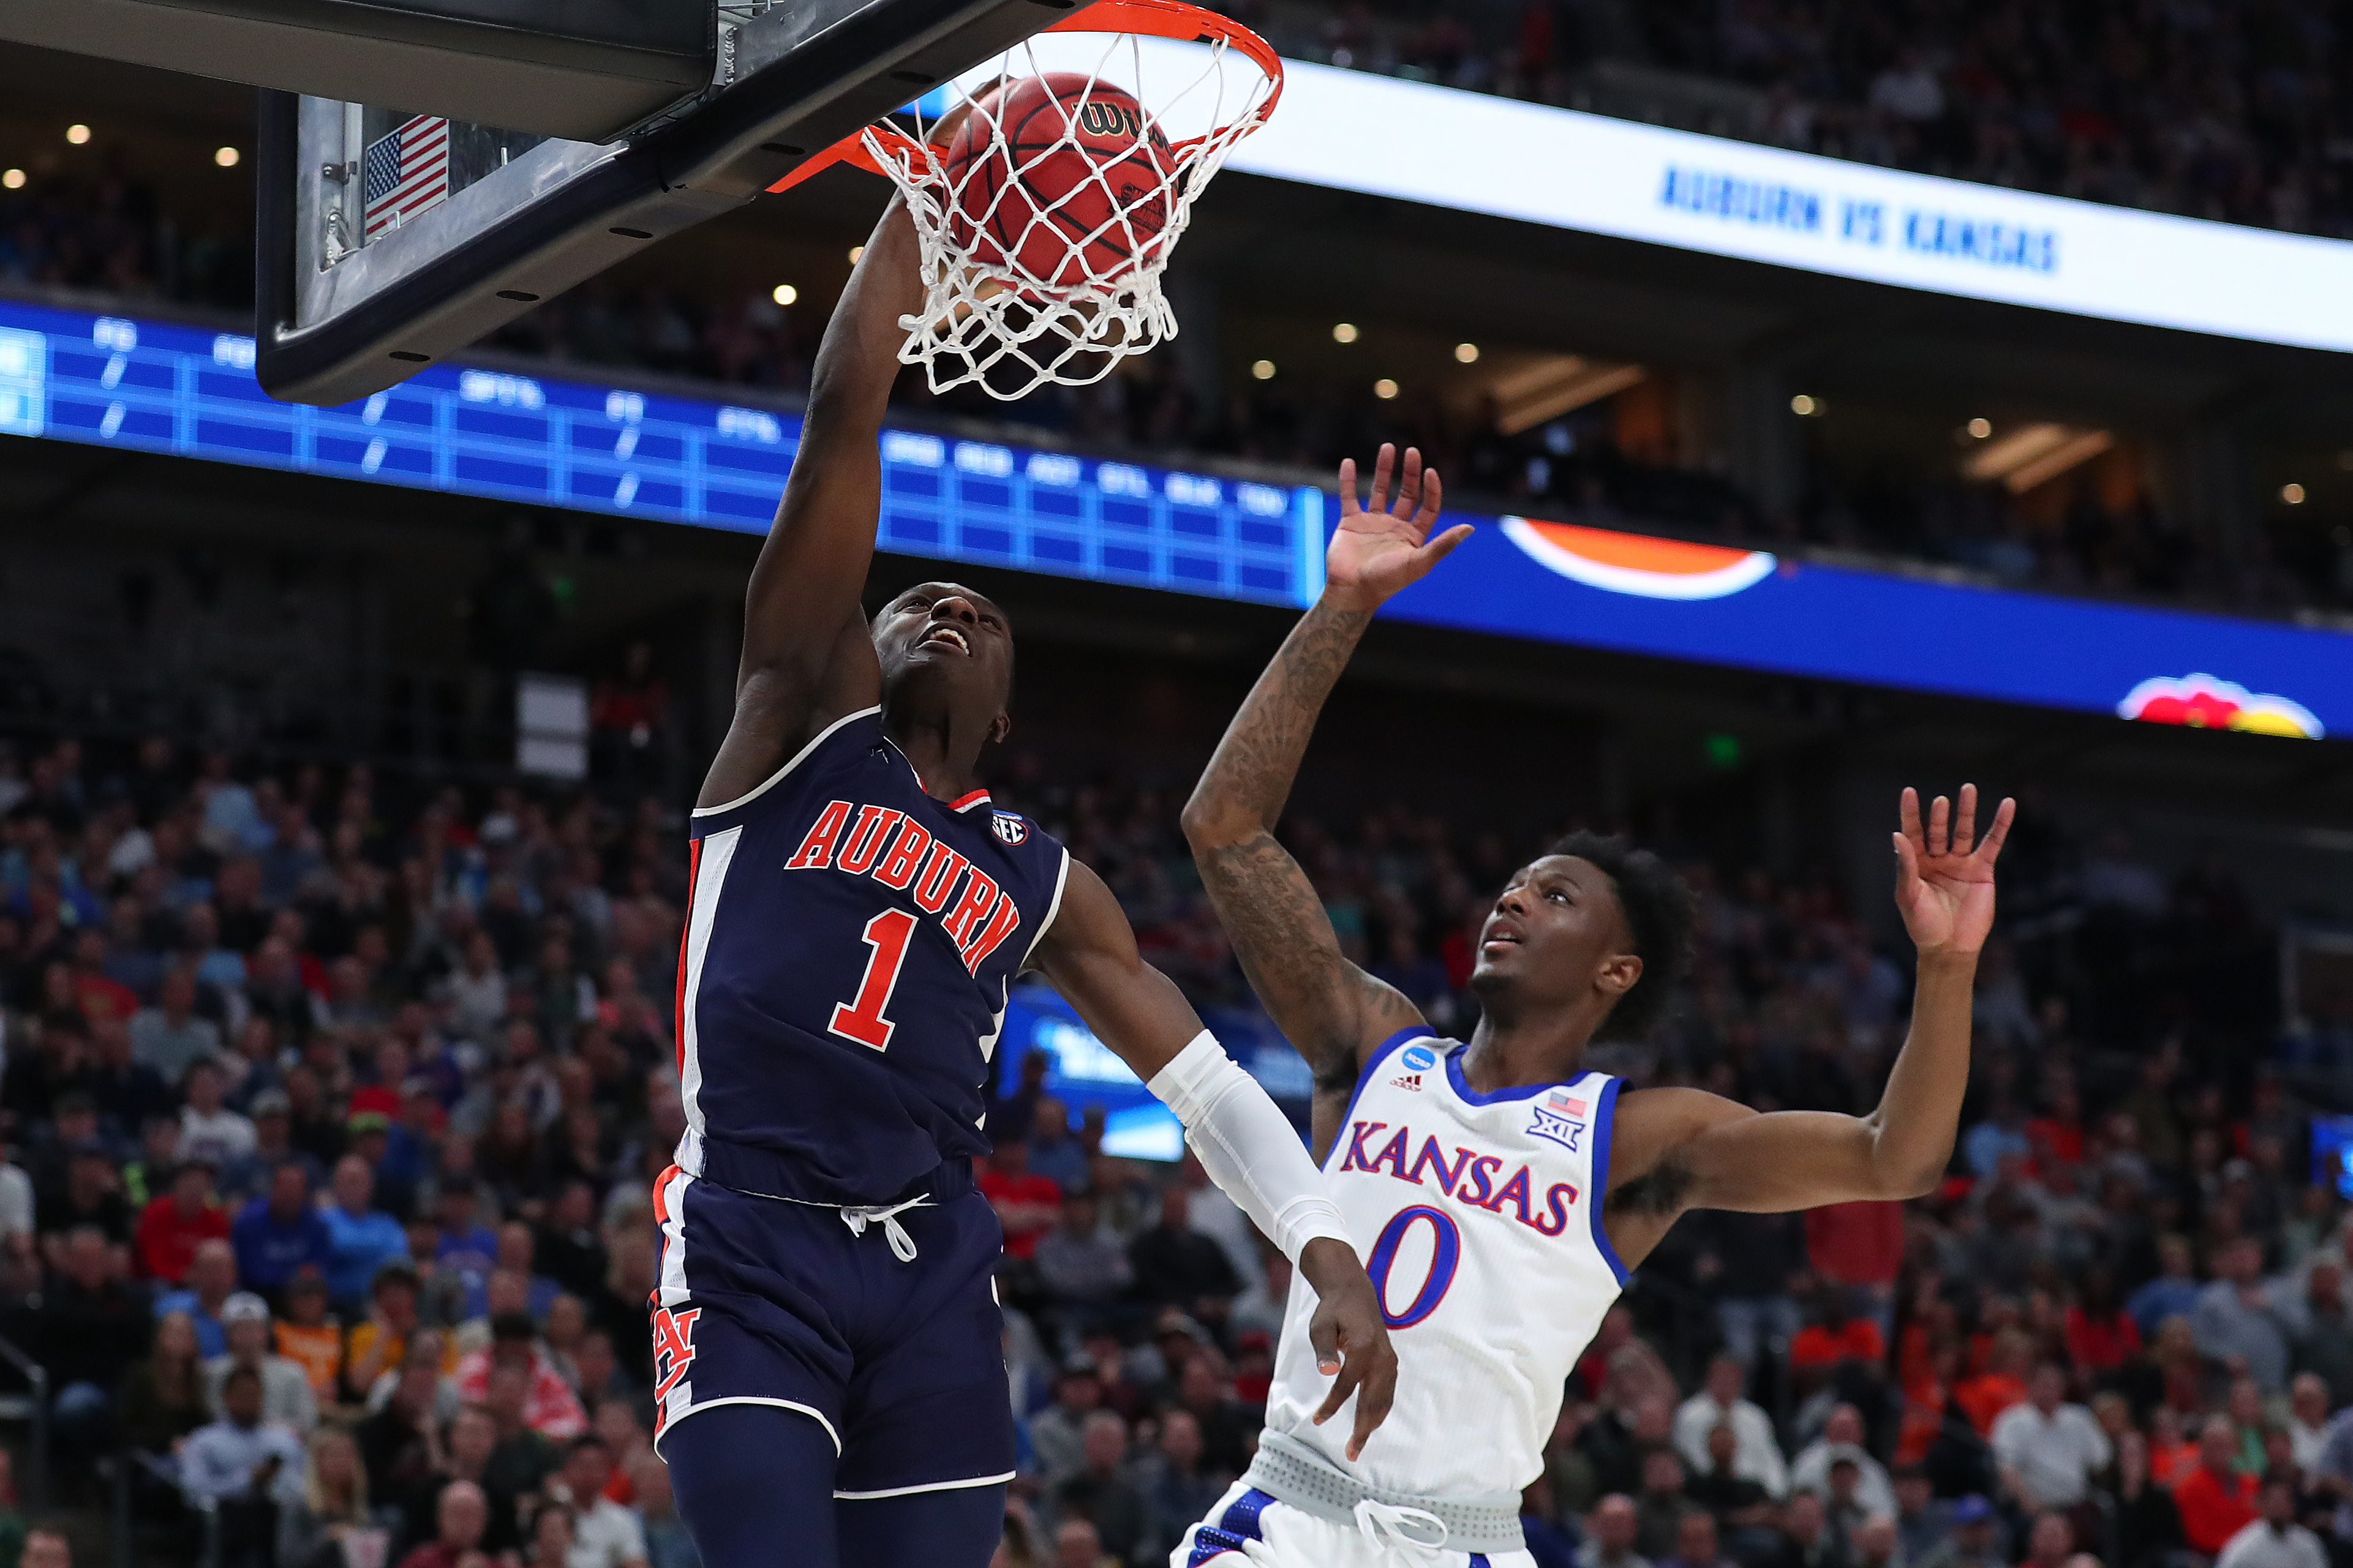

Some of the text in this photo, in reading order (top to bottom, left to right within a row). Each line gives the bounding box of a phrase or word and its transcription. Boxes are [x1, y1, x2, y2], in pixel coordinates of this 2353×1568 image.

[1658, 164, 2060, 274] AUBURN VS KANSAS
[992, 816, 1024, 843] SEC
[783, 800, 1020, 980] AUBURN
[827, 907, 919, 1053] 1
[1340, 1121, 1578, 1236] KANSAS
[1366, 1204, 1461, 1329] 0
